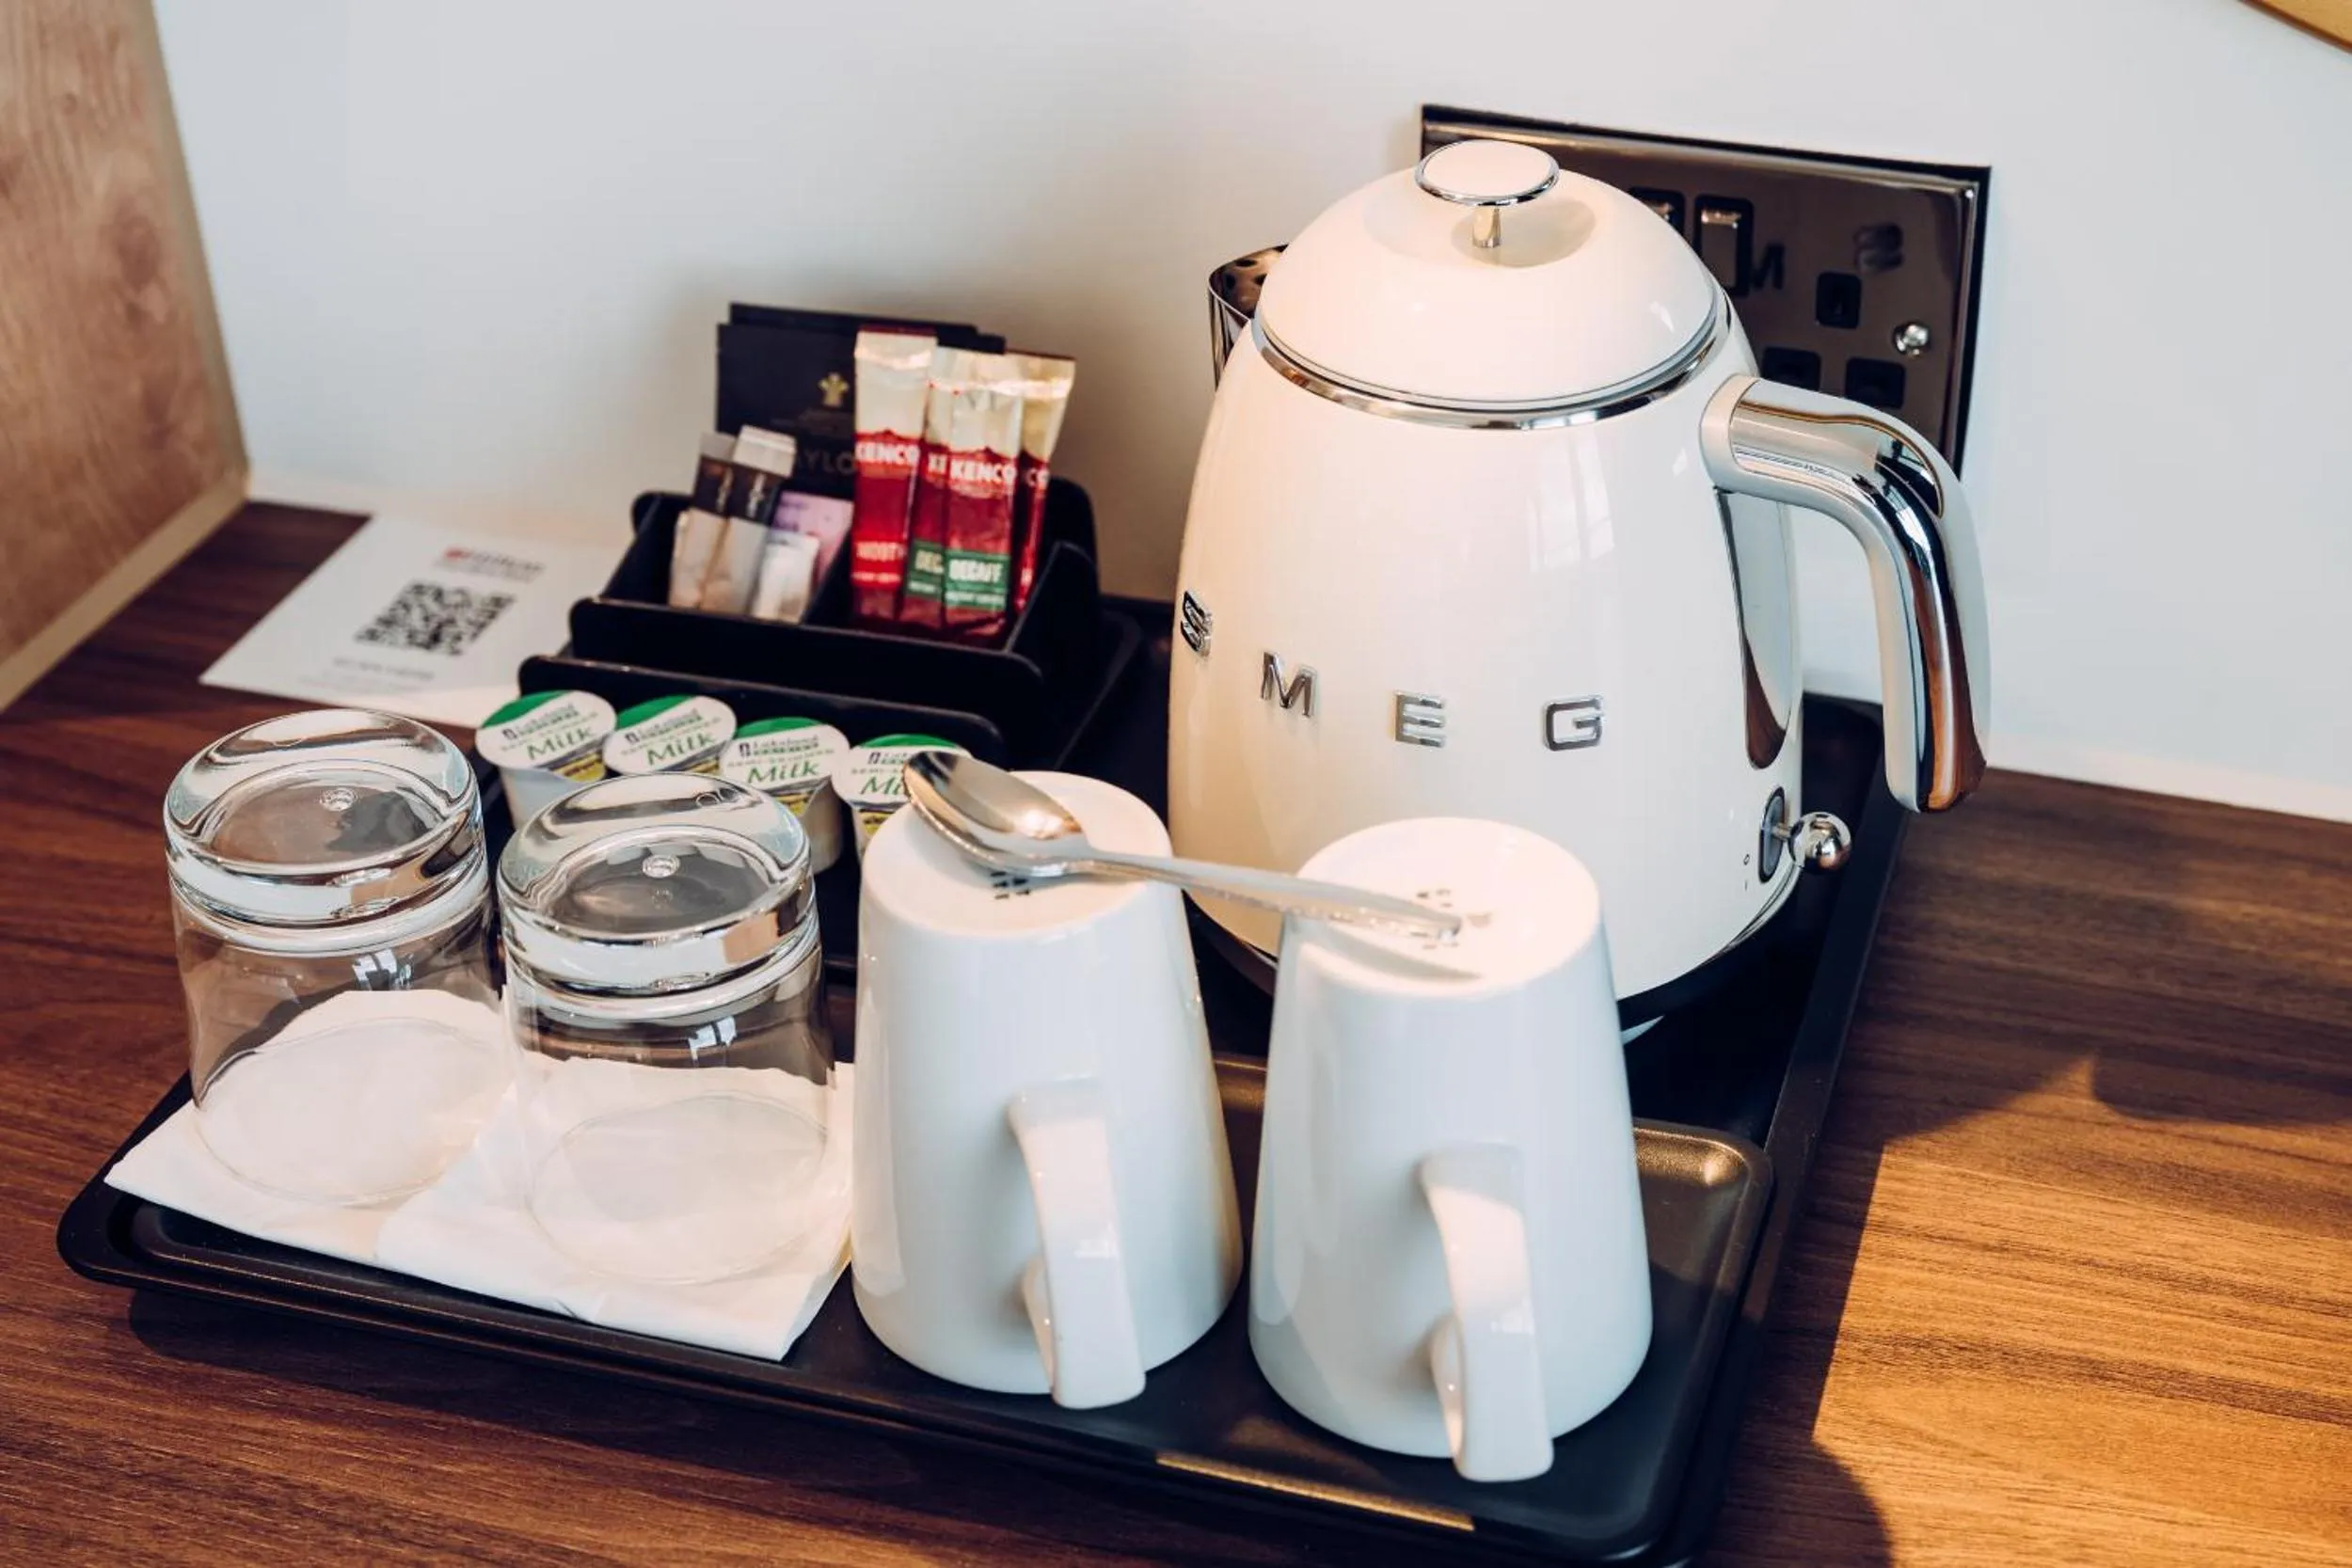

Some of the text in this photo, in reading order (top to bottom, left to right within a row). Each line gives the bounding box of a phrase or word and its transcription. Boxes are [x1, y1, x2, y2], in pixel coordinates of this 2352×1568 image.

[949, 456, 1017, 486] KENCO
[1180, 589, 1605, 752] SMEG
[527, 726, 592, 760] Milk
[646, 733, 716, 766] Milk
[748, 760, 820, 784] Milk
